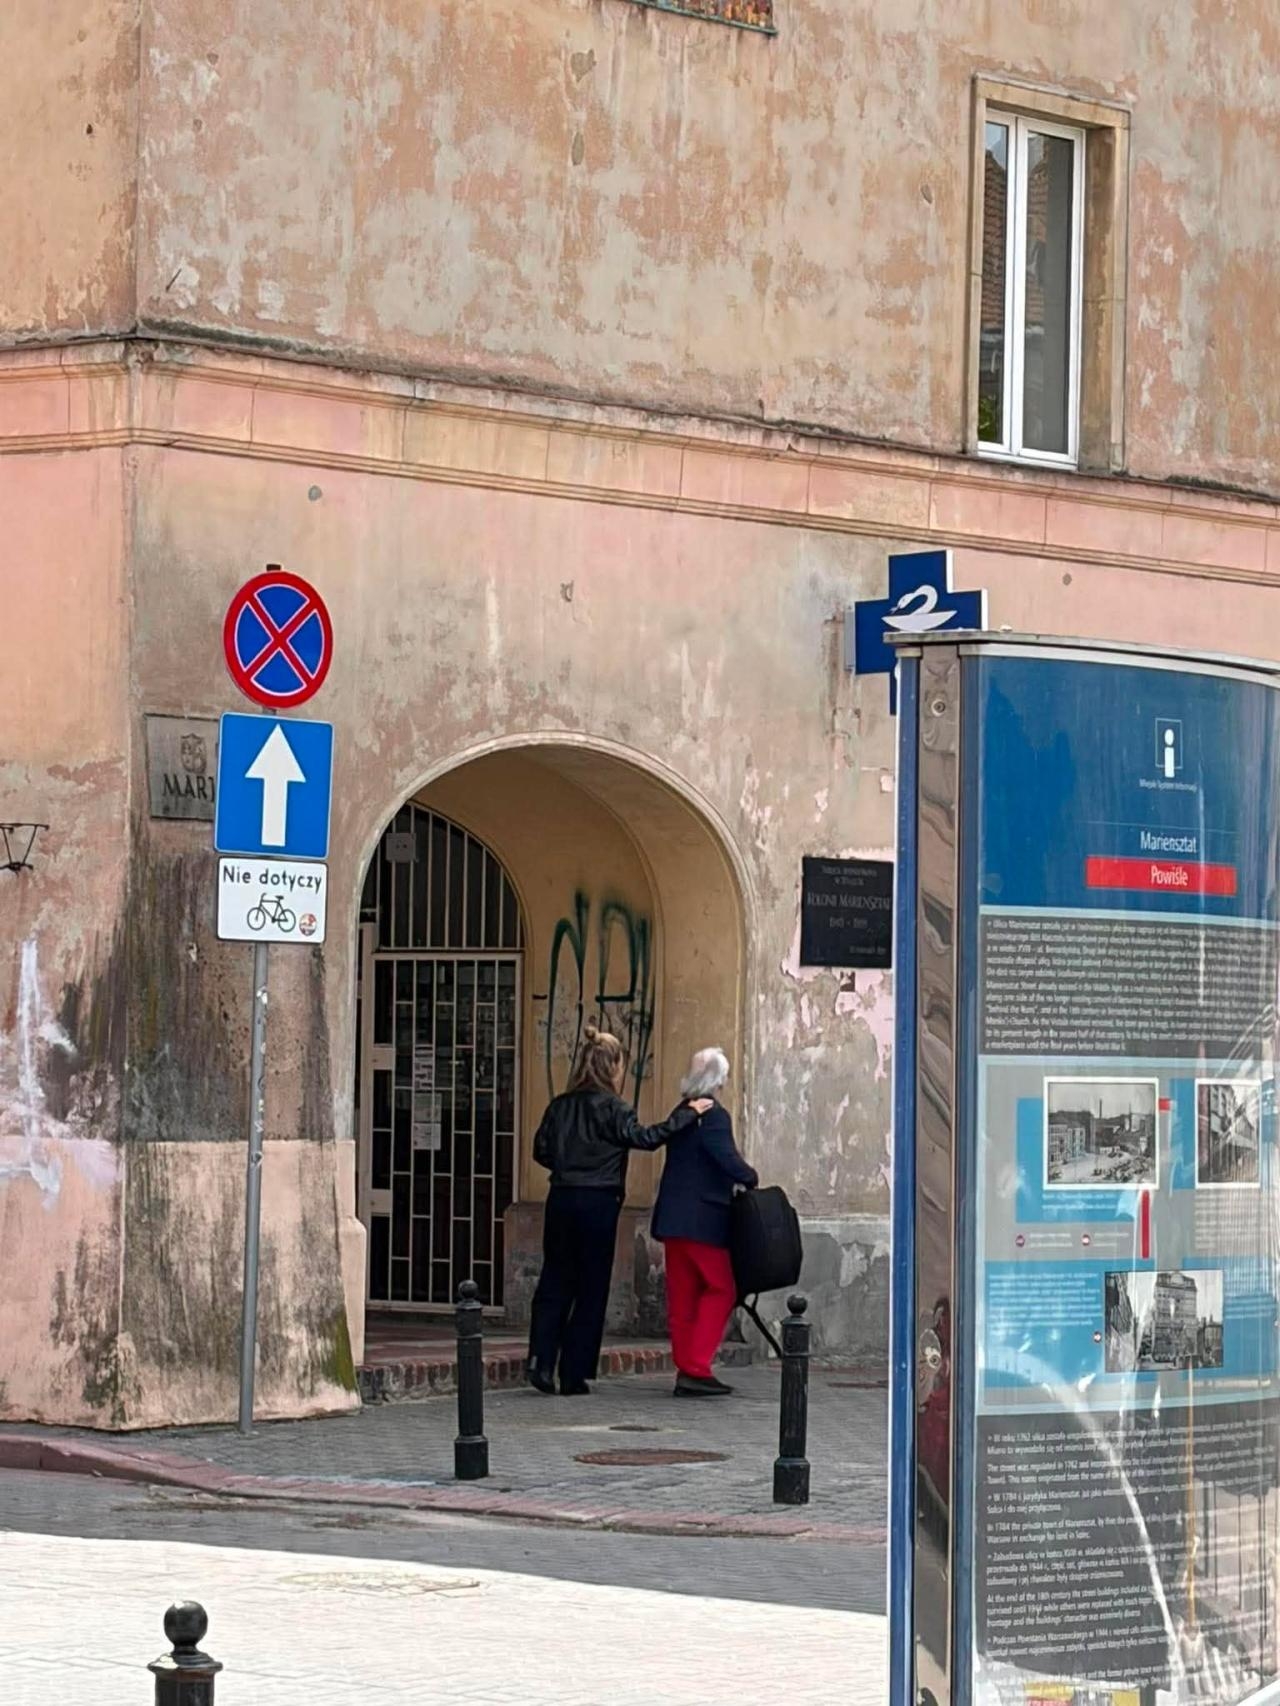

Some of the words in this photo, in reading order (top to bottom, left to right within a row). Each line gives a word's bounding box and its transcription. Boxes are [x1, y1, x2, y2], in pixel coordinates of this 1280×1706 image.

[1140, 831, 1197, 853] Mariensztat
[223, 865, 251, 884] Nie
[259, 868, 322, 894] dotyczy
[1151, 865, 1189, 886] Powiśle
